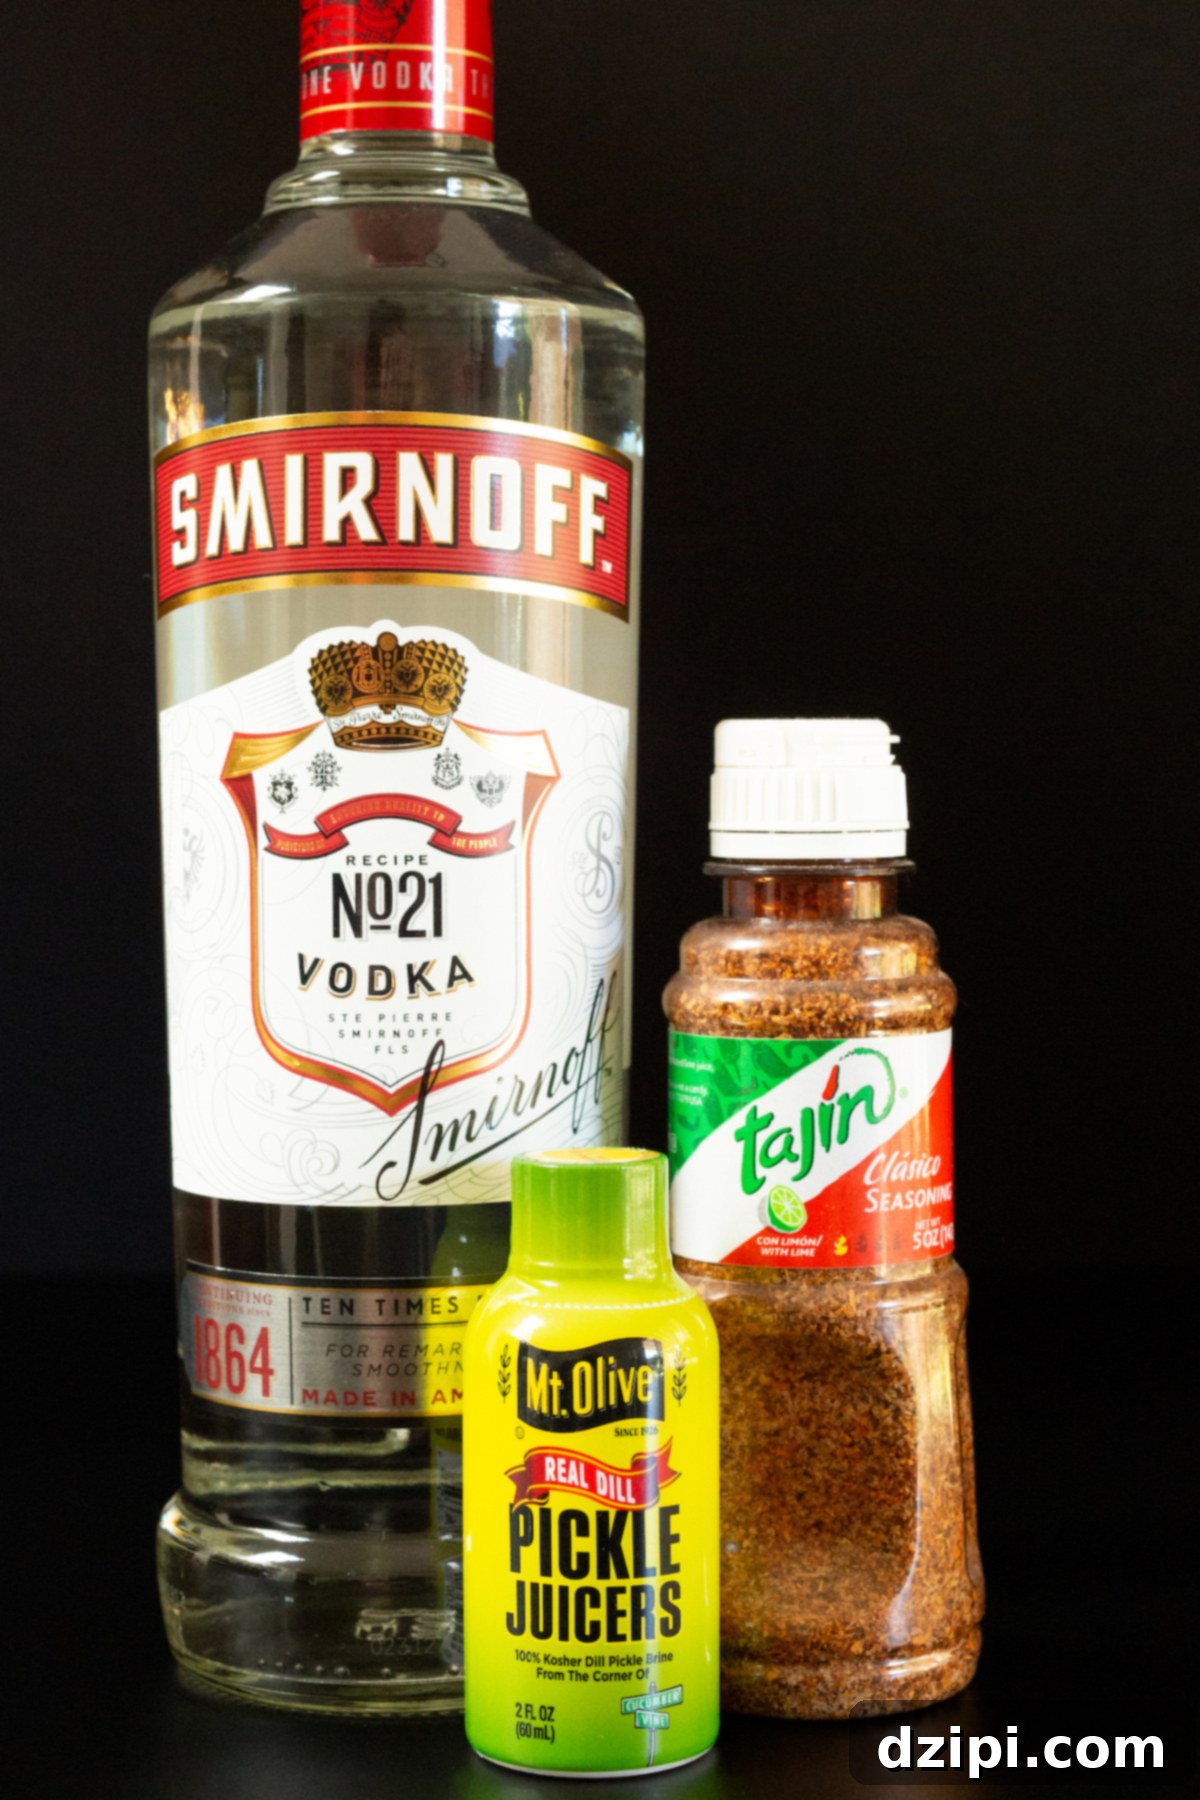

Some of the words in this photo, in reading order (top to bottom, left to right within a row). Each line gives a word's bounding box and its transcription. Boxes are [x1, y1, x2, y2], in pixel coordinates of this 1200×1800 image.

[350, 61, 453, 92] VODKA
[171, 451, 608, 567] SMIRNOFF
[346, 854, 429, 866] RECIPE
[297, 952, 475, 1001] VODKA
[328, 1013, 362, 1023] STE
[378, 1012, 452, 1022] PIERRE
[338, 1028, 442, 1039] SMIRNOFF
[374, 1045, 409, 1055] FLS
[357, 970, 618, 1201] Smirnoff
[863, 1151, 941, 1186] Clásico
[864, 1182, 952, 1213] SEASONING
[756, 1236, 780, 1246] CON
[761, 1247, 789, 1256] WITH
[790, 1247, 816, 1257] LIME
[303, 1297, 355, 1315] TEN
[376, 1296, 460, 1316] TIMES
[194, 1315, 274, 1398] 1864
[326, 1343, 370, 1358] FOR
[526, 1357, 570, 1418] Mt.
[571, 1355, 654, 1416] Olive
[302, 1388, 377, 1407] MADE
[391, 1390, 416, 1406] IN
[544, 1456, 589, 1489] REAL
[596, 1470, 636, 1504] DILL
[509, 1503, 681, 1580] PICKLE
[506, 1580, 682, 1643] JUICERS
[515, 1649, 541, 1664] 100%
[543, 1654, 582, 1667] Kosher
[585, 1655, 606, 1667] Dill
[609, 1654, 643, 1667] Pickle
[646, 1652, 674, 1664] Brine
[536, 1668, 565, 1681] From
[568, 1670, 589, 1682] The
[593, 1670, 632, 1682] Corner
[636, 1668, 649, 1680] Of
[626, 1690, 680, 1711] CUCUMBER
[515, 1702, 522, 1718] 2
[539, 1705, 555, 1722] OZ
[641, 1714, 666, 1727] VINE
